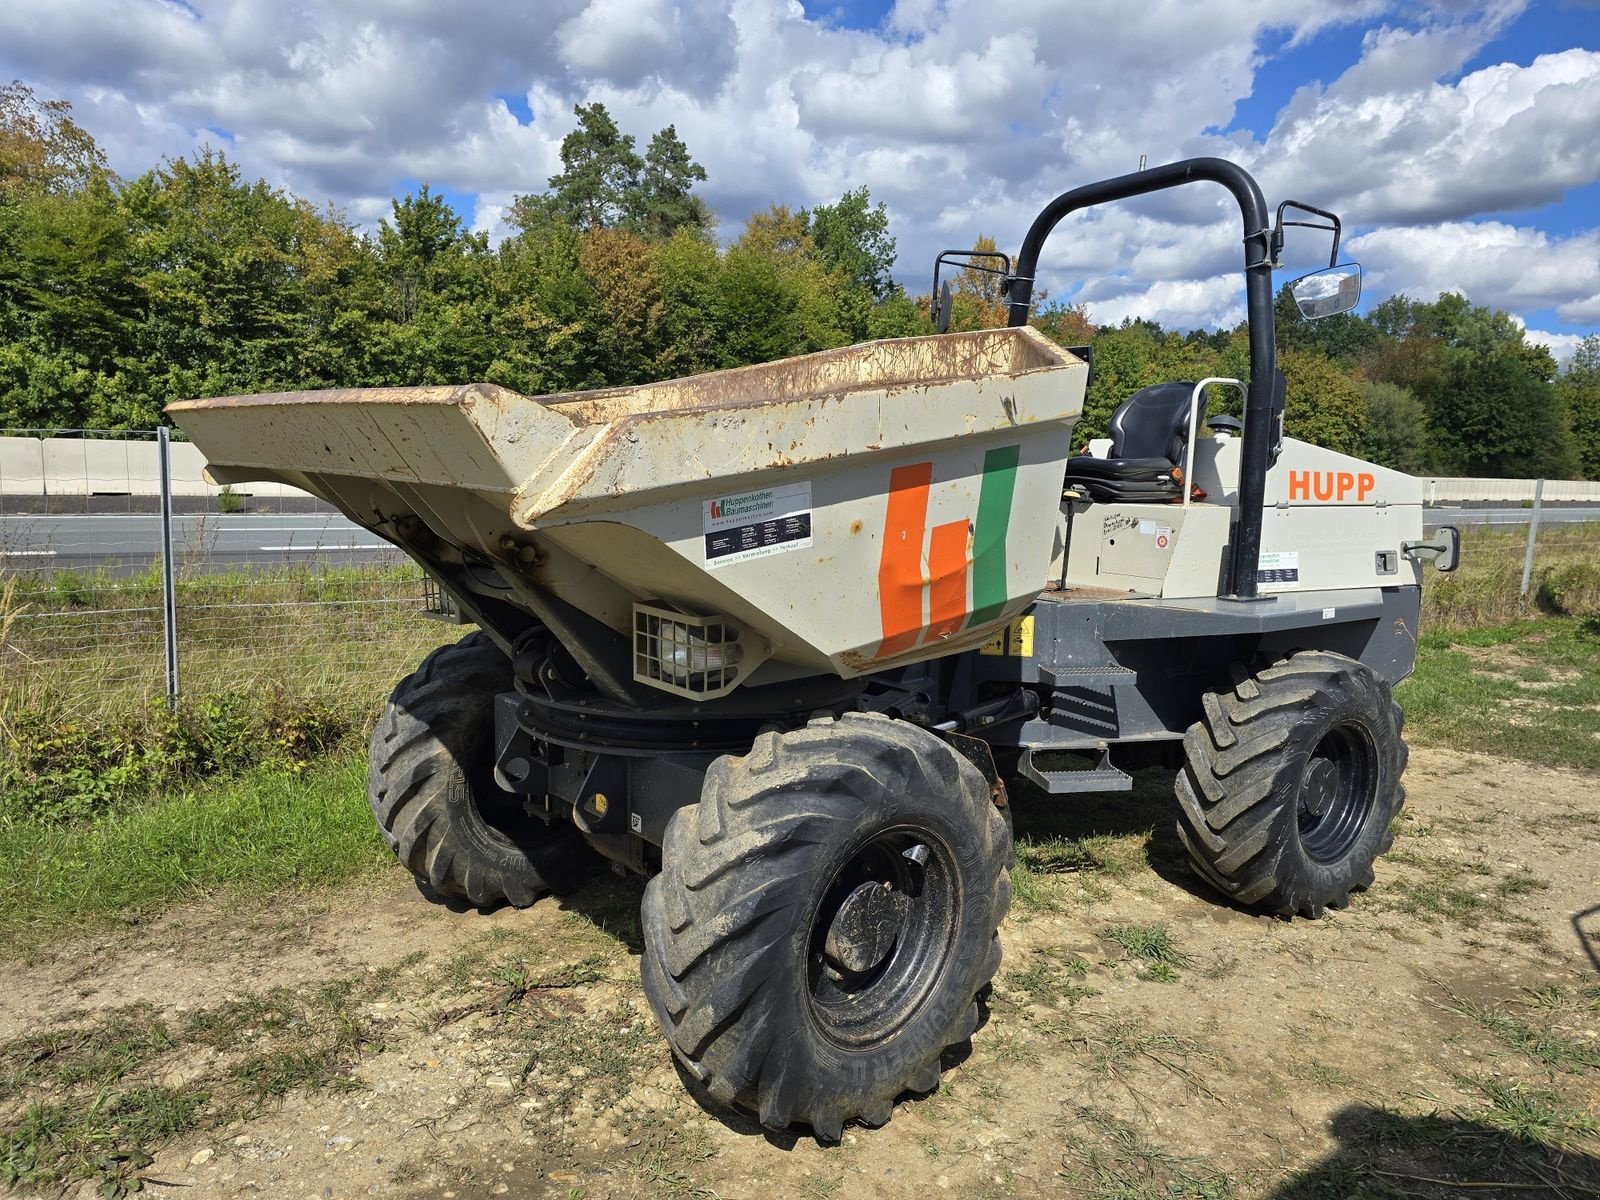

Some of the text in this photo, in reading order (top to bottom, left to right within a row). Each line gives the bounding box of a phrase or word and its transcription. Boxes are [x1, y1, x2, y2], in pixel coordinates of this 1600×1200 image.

[1289, 470, 1375, 502] HUPP
[725, 491, 773, 508] Huppenkothen
[725, 501, 774, 517] Baumaschinen
